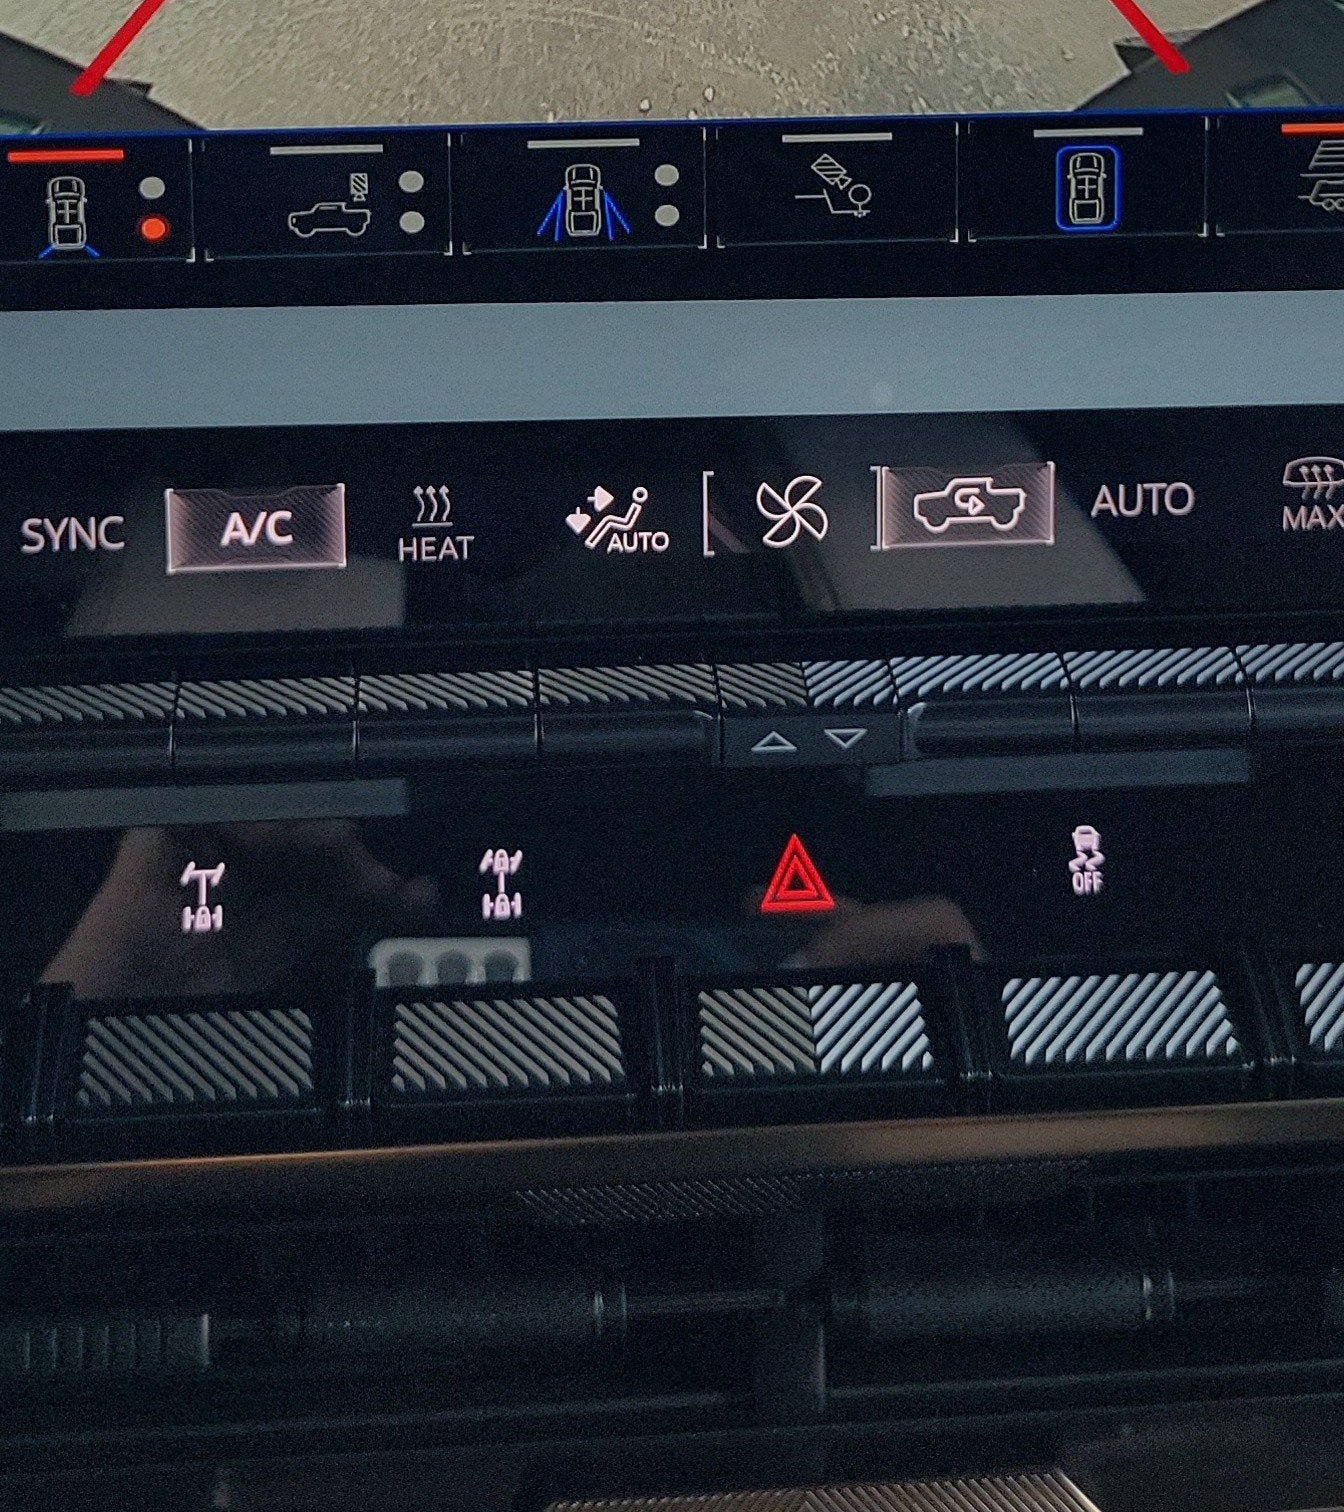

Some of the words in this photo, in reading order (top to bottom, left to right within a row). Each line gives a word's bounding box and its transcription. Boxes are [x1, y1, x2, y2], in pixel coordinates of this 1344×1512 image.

[1089, 480, 1196, 519] AUTO
[20, 514, 126, 555] SYNC
[219, 509, 294, 547] A/C
[607, 531, 670, 554] AUTO
[397, 534, 475, 563] HEAT
[1071, 871, 1104, 895] OFF
